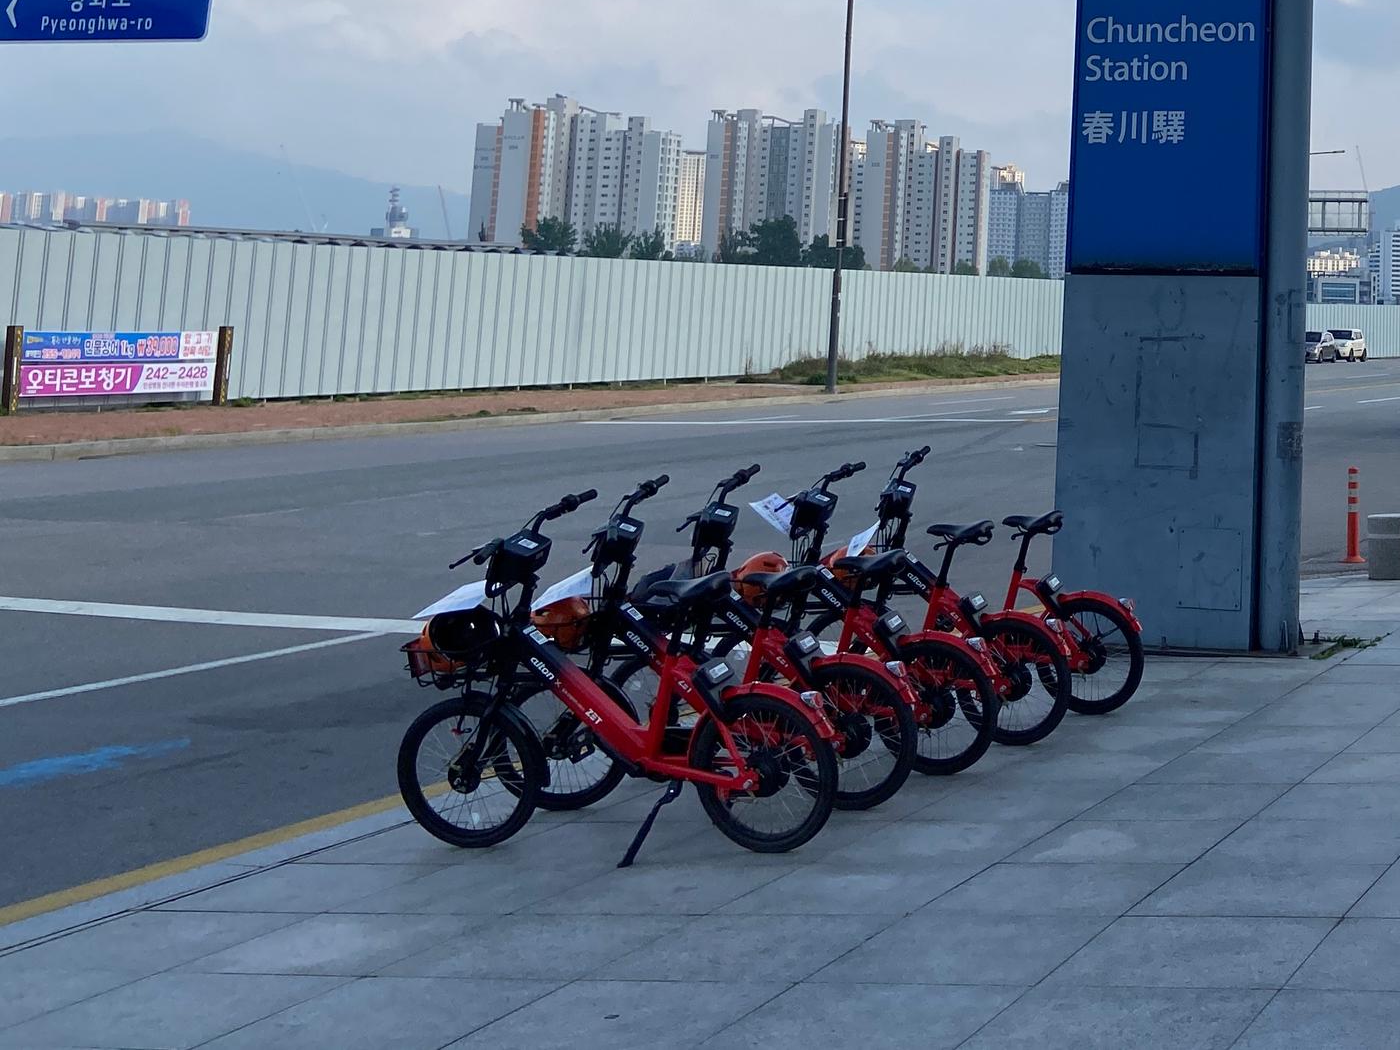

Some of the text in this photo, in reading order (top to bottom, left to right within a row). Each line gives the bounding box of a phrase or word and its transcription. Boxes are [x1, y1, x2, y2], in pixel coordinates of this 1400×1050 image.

[41, 15, 153, 34] Pyeonghwa-ro
[1086, 14, 1255, 43] Chuncheon
[1085, 54, 1188, 81] Station
[1082, 110, 1185, 144] 春川驛
[84, 338, 119, 357] 민물장어
[26, 366, 132, 391] 오티콘보청기
[145, 366, 208, 380] 242-2428
[821, 588, 841, 608] alton
[726, 611, 749, 631] alton
[626, 630, 650, 653] alton
[530, 656, 556, 681] alton
[584, 707, 603, 725] ZET
